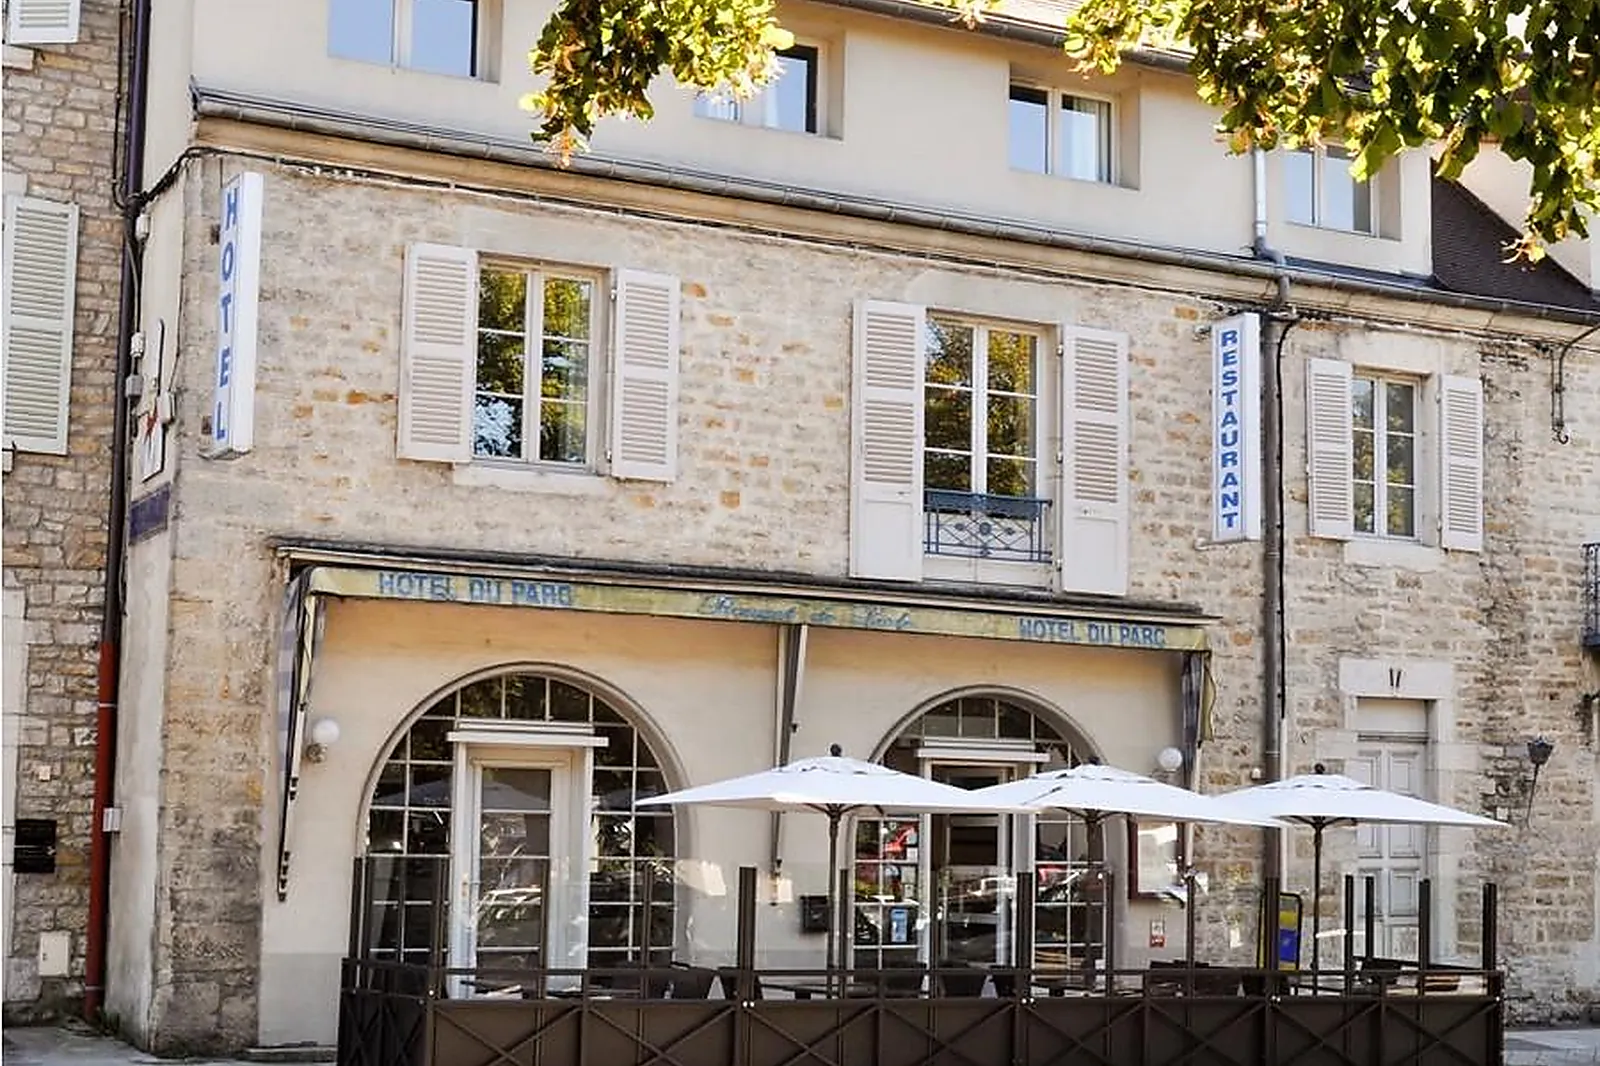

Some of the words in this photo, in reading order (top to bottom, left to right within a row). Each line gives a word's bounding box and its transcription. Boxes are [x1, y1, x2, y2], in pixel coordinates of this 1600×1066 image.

[215, 187, 239, 440] HOTEL
[1220, 329, 1239, 528] RESTAURANT
[379, 571, 454, 600] HOTEL
[1019, 617, 1080, 642] HOTEL
[1119, 625, 1166, 648] PARC
